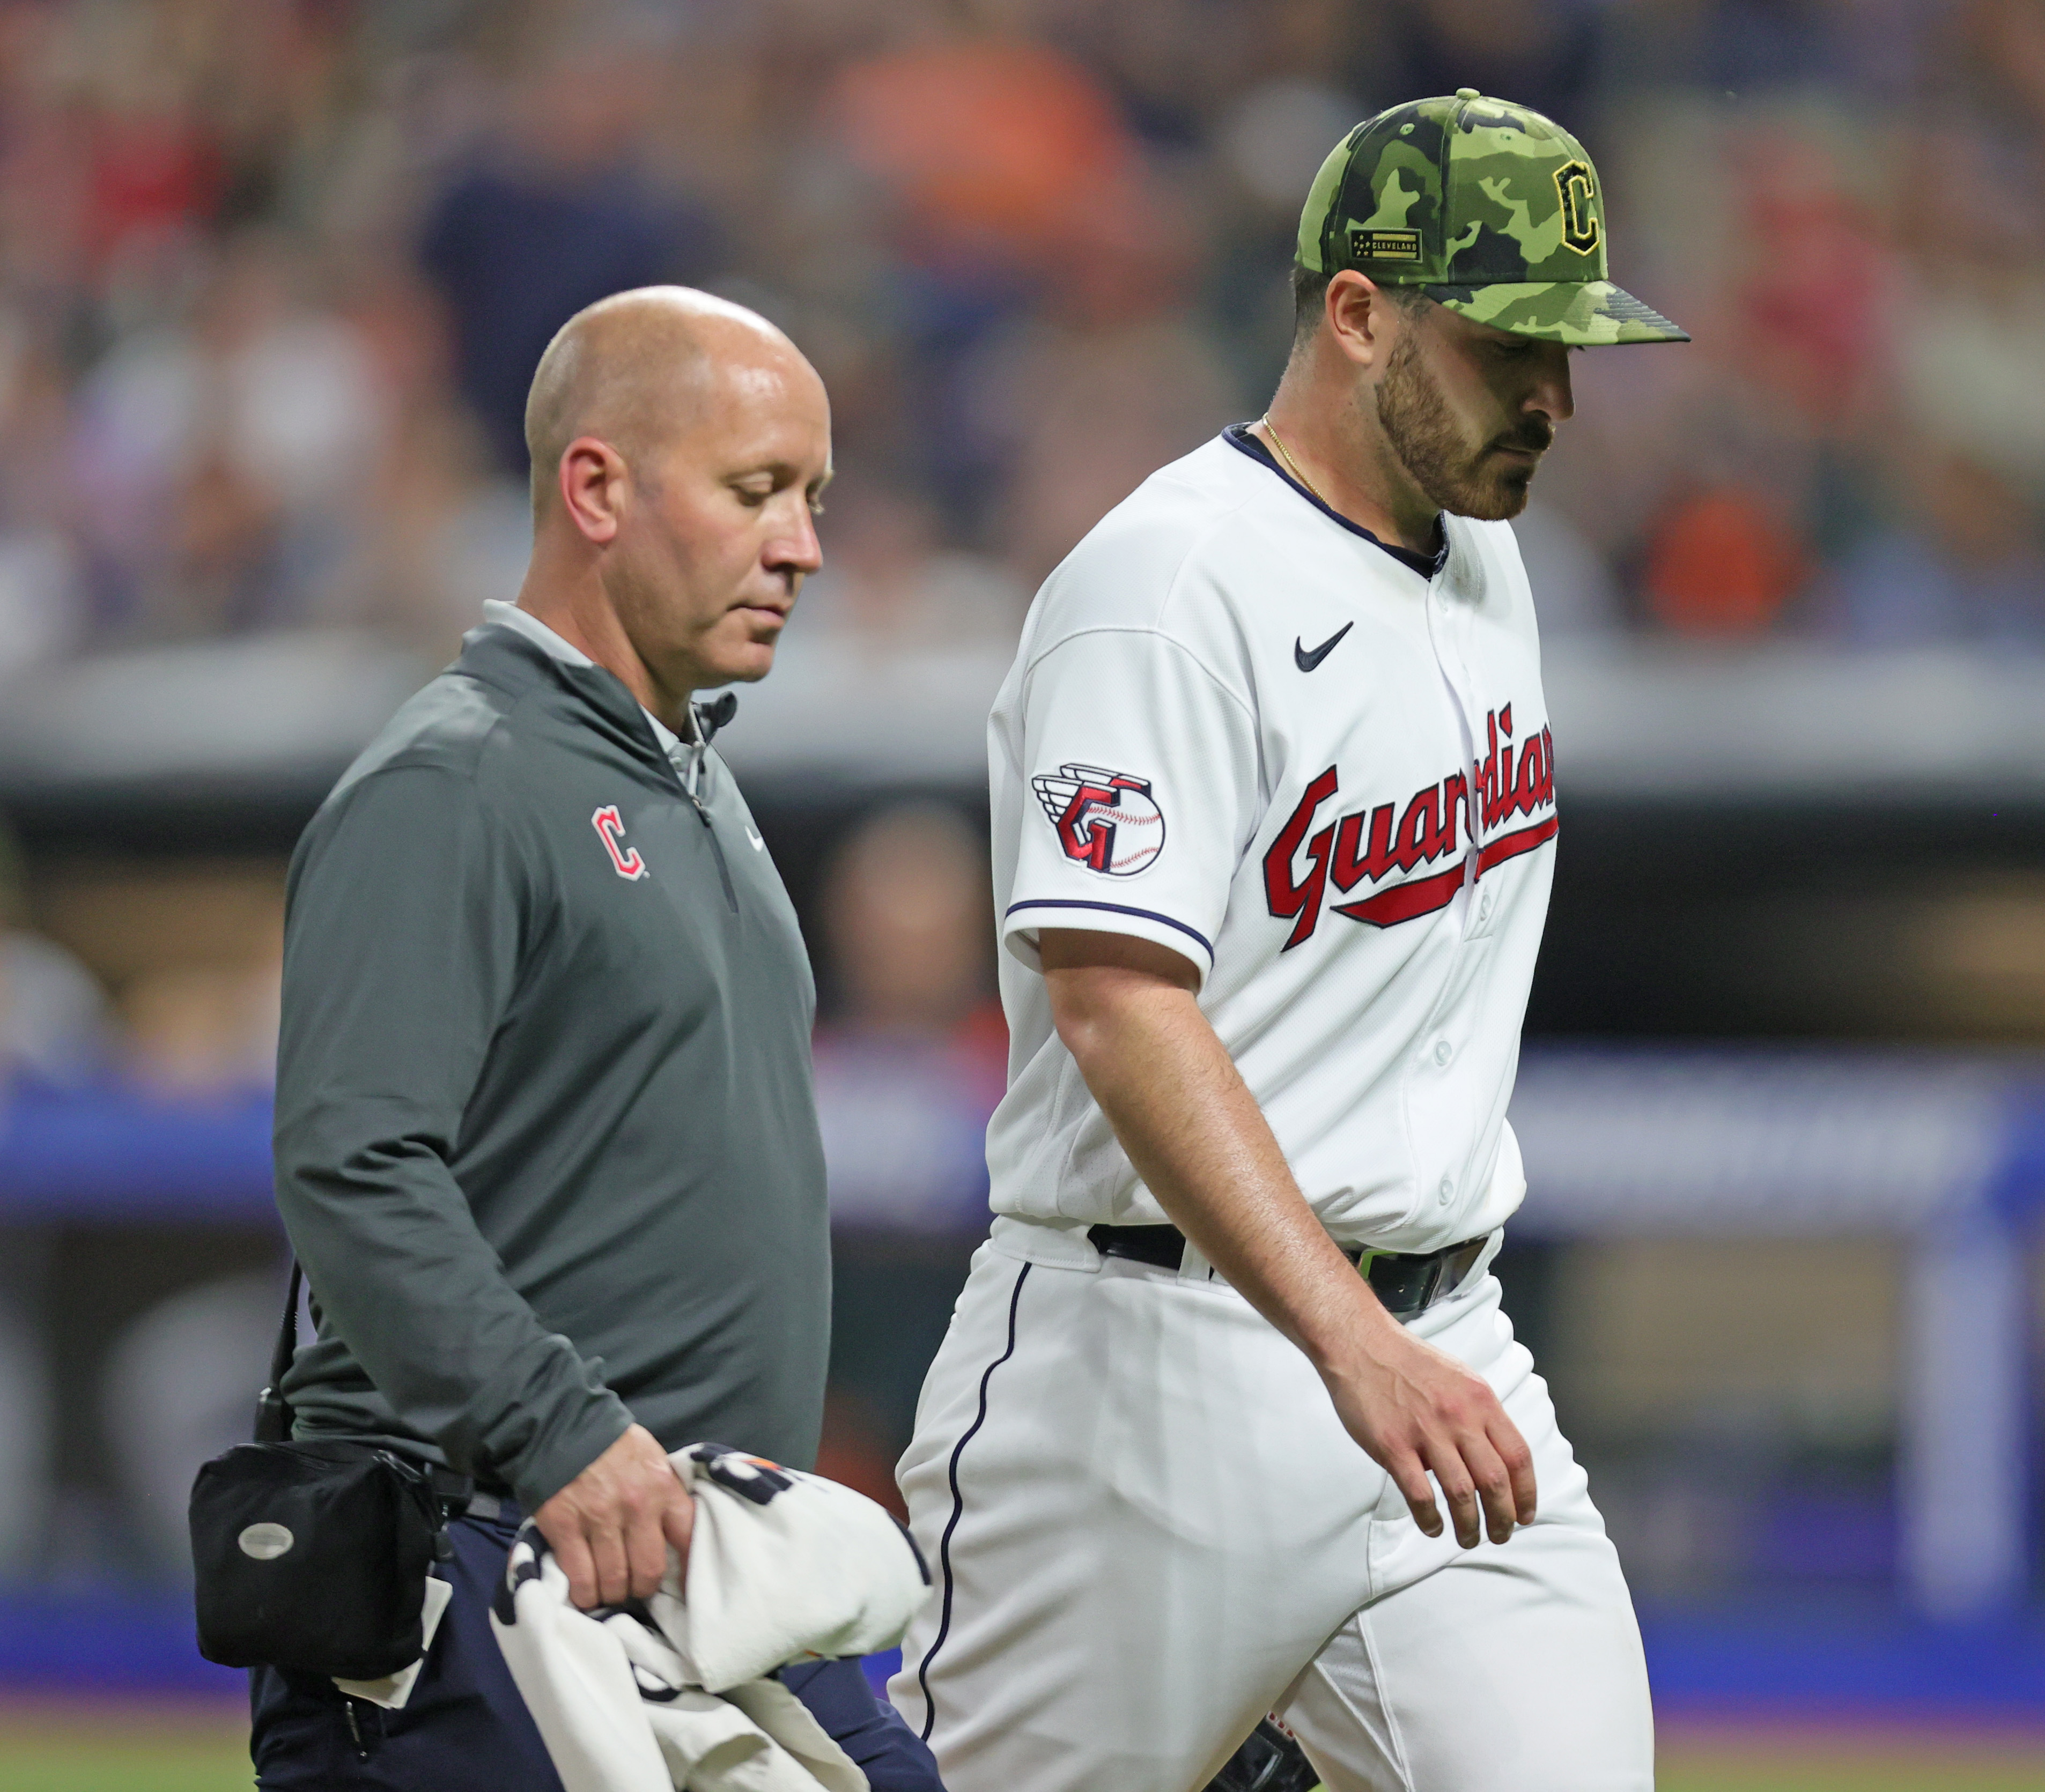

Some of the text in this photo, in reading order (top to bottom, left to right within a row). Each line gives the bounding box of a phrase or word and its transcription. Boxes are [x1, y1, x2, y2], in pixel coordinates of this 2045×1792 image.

[1372, 241, 1417, 251] CLEVELAND
[1552, 159, 1600, 257] C
[591, 804, 646, 882] C
